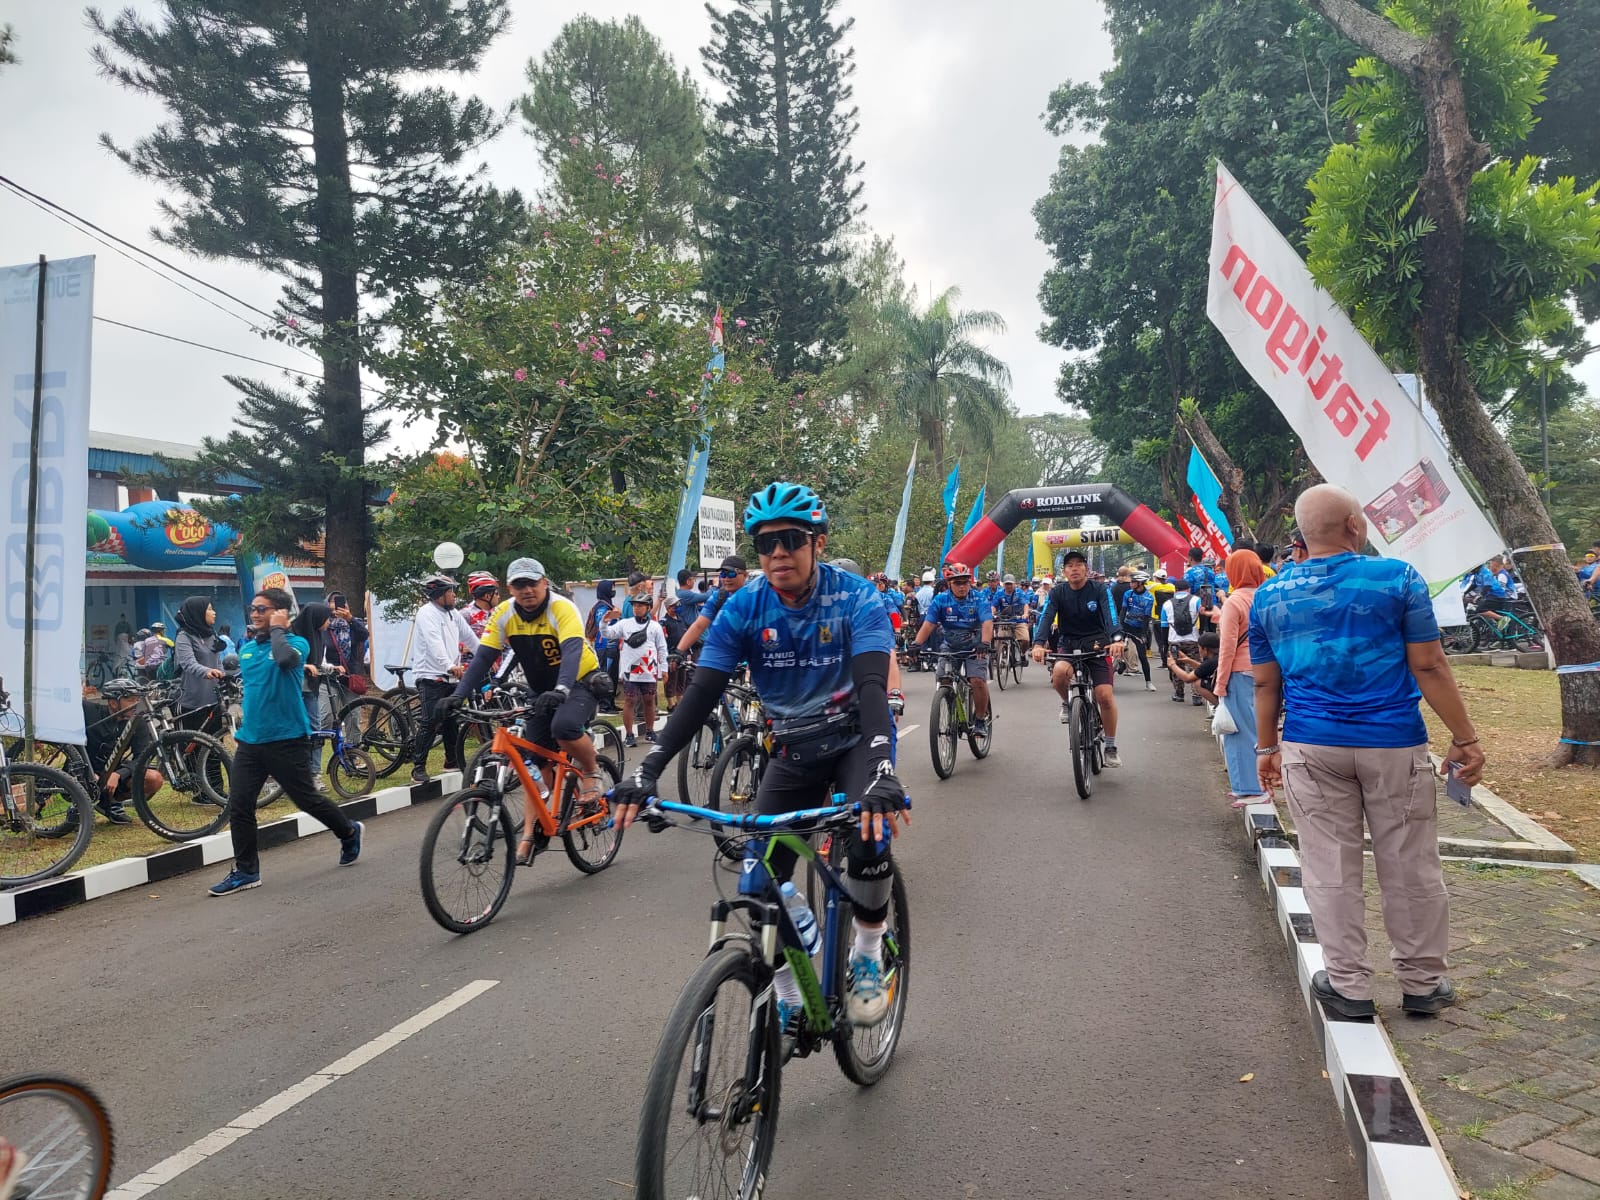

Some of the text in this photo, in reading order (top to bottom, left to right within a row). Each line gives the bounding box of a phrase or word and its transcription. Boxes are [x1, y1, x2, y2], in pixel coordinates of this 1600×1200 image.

[1036, 493, 1102, 507] RODALINK
[1081, 529, 1120, 544] START
[763, 651, 795, 659] LANUD
[104, 720, 132, 771] UNITED
